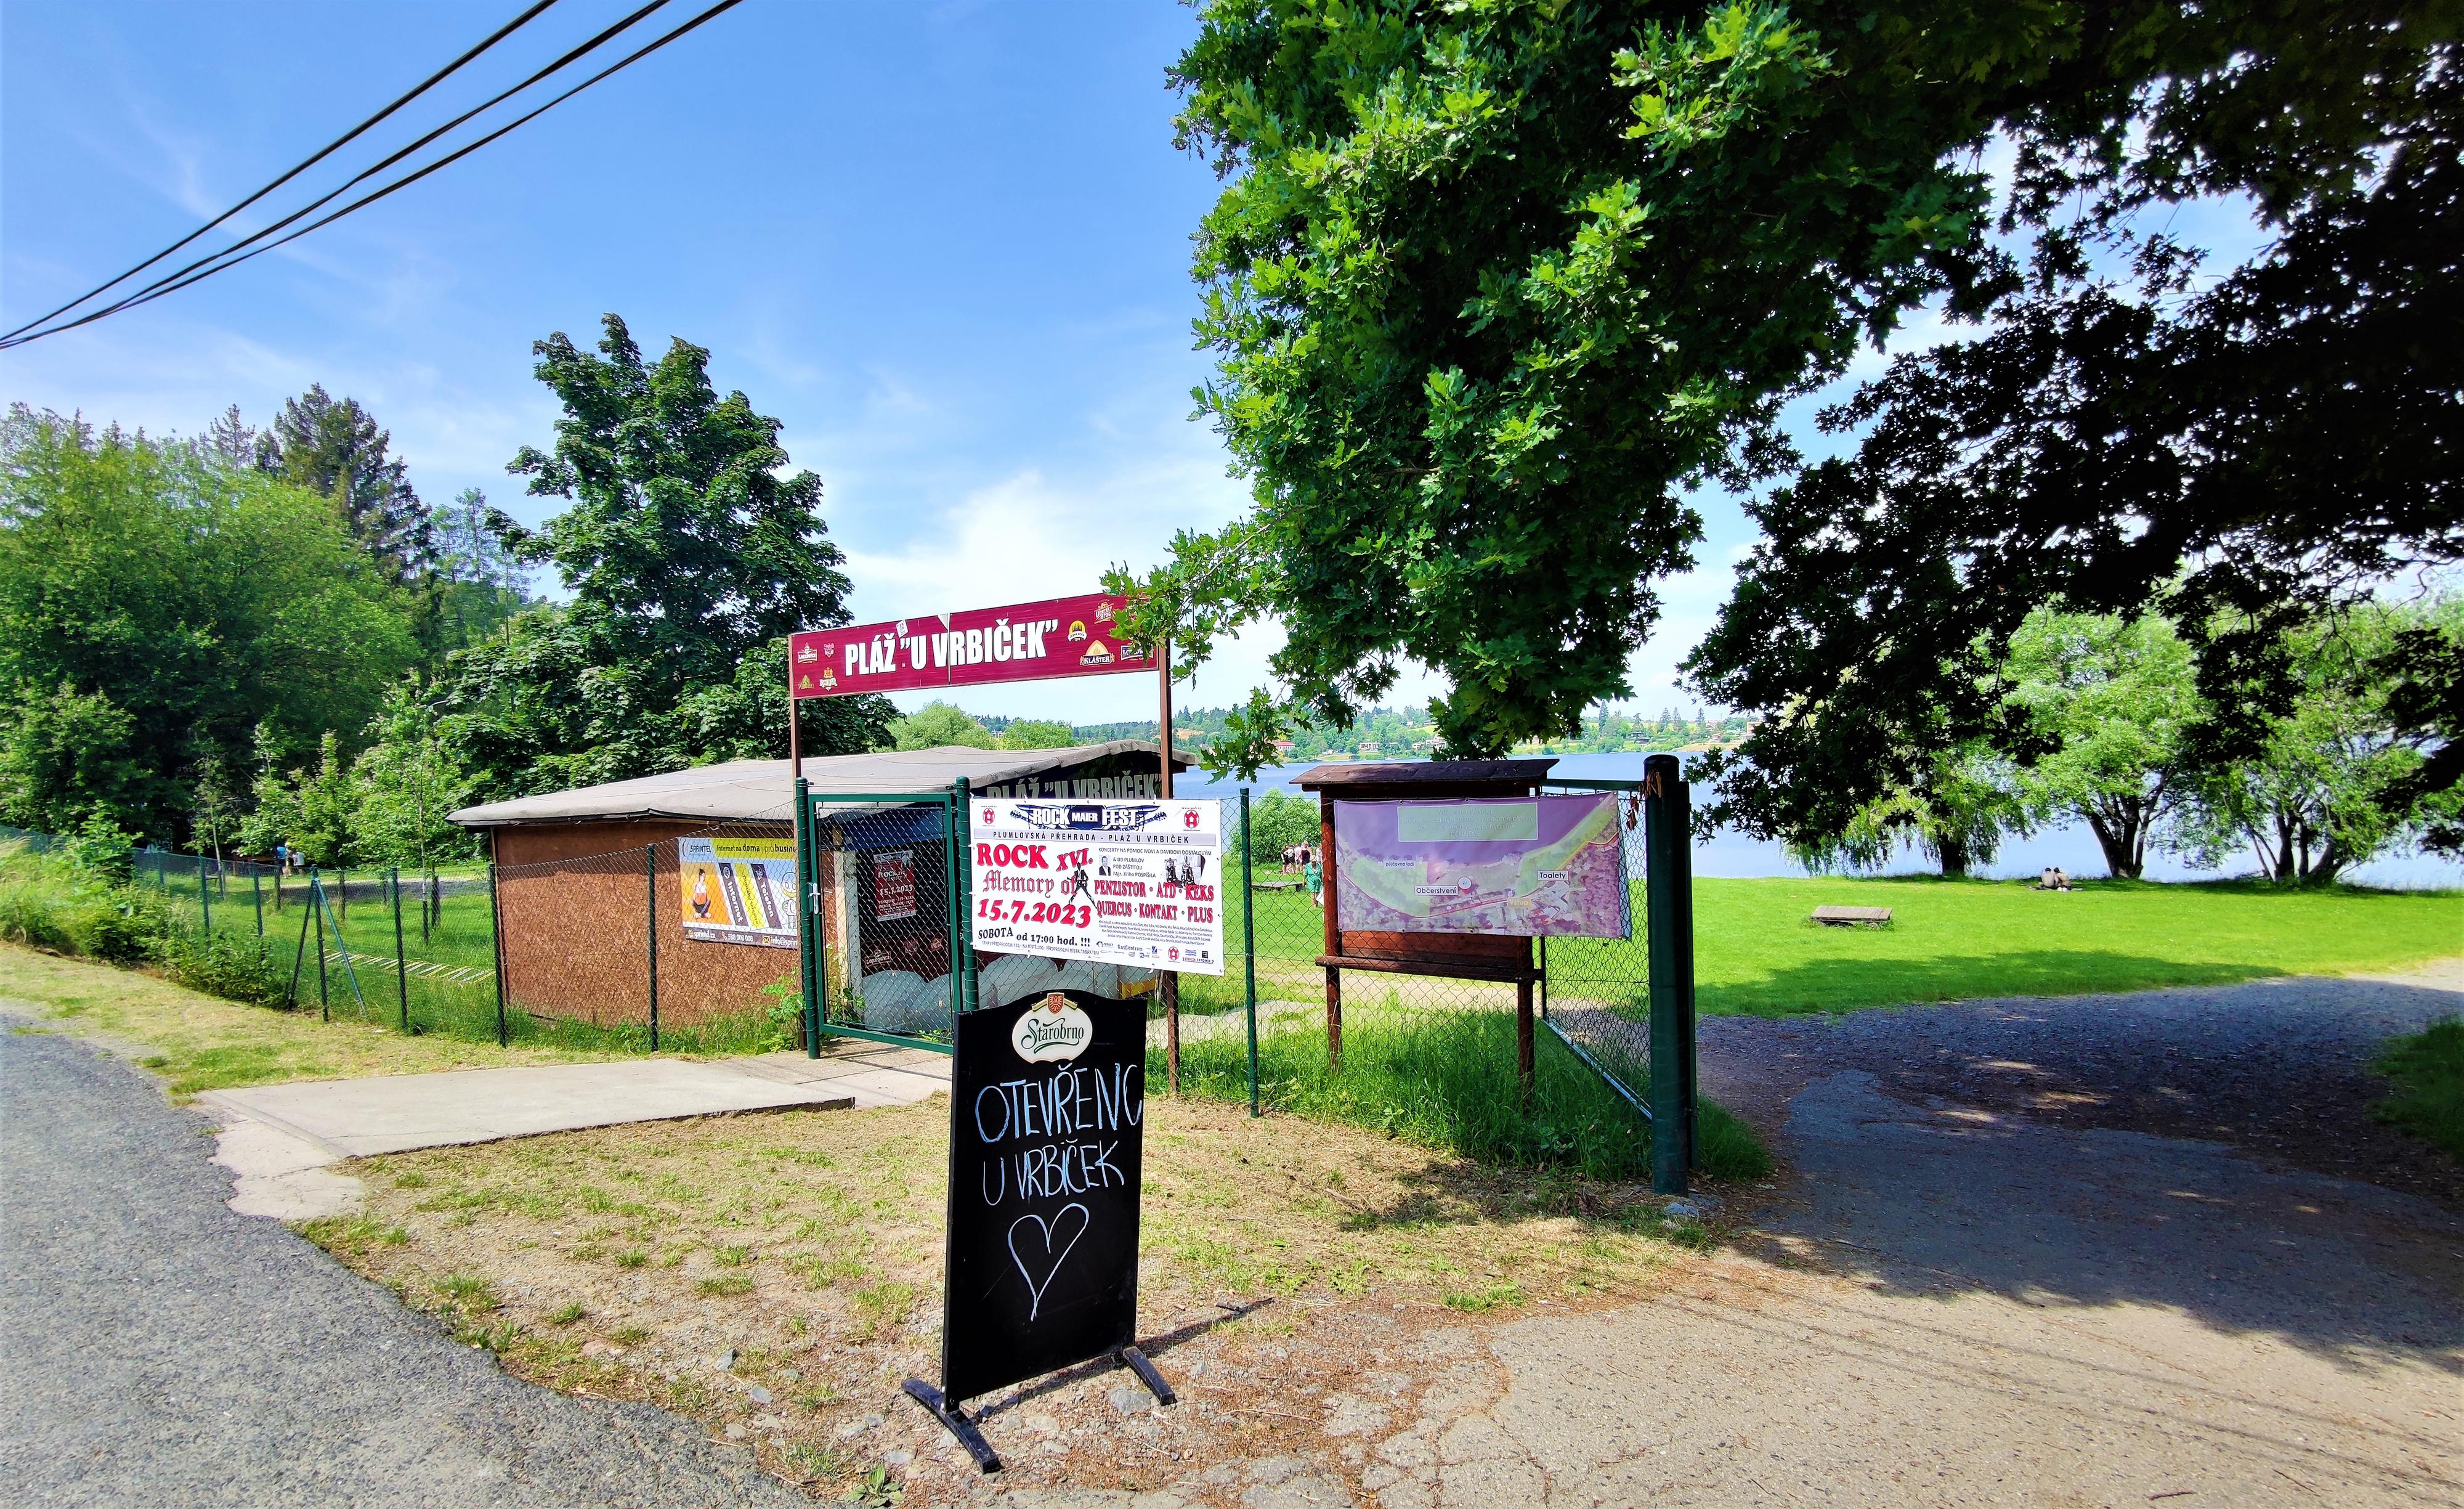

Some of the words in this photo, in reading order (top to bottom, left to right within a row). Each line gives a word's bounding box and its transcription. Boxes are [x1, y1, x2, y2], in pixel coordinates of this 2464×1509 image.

[845, 633, 896, 677] PLÁŽ
[1084, 656, 1111, 665] KLÁŠTER
[1030, 808, 1071, 826] ROCK
[1071, 812, 1098, 823] MAIER
[1101, 808, 1138, 827] FEST
[742, 844, 760, 852] doma
[764, 846, 774, 854] pro
[993, 831, 1046, 840] PLUMLOVSKÁ
[1050, 832, 1096, 841] PŘEHRADA
[1109, 833, 1131, 842] PLÁŽ
[1147, 835, 1189, 844] VRBIČEK
[976, 843, 1049, 869] ROCK
[1056, 848, 1093, 872] XVI.
[983, 869, 1055, 898] Memory
[1539, 872, 1566, 880] Toalety
[727, 881, 744, 922] Internet
[761, 882, 775, 918] Telefon
[1094, 880, 1146, 898] PENZISTOR
[1156, 882, 1177, 898] ATD
[1185, 884, 1214, 902] KEKS
[978, 898, 1092, 929] 15.7.2023
[1096, 900, 1132, 918] QUERCUS
[1139, 903, 1178, 921] KONTAKT
[1187, 906, 1214, 924] PLUS
[978, 927, 1014, 940] SOBOTA
[1016, 932, 1027, 941] od
[1031, 934, 1054, 944] 17:00
[1056, 935, 1078, 946] hod.
[1080, 937, 1090, 947] !!!
[1021, 1017, 1084, 1054] Starobrno
[983, 1157, 1005, 1206] U
[1015, 1138, 1125, 1200] VRBIČEK
